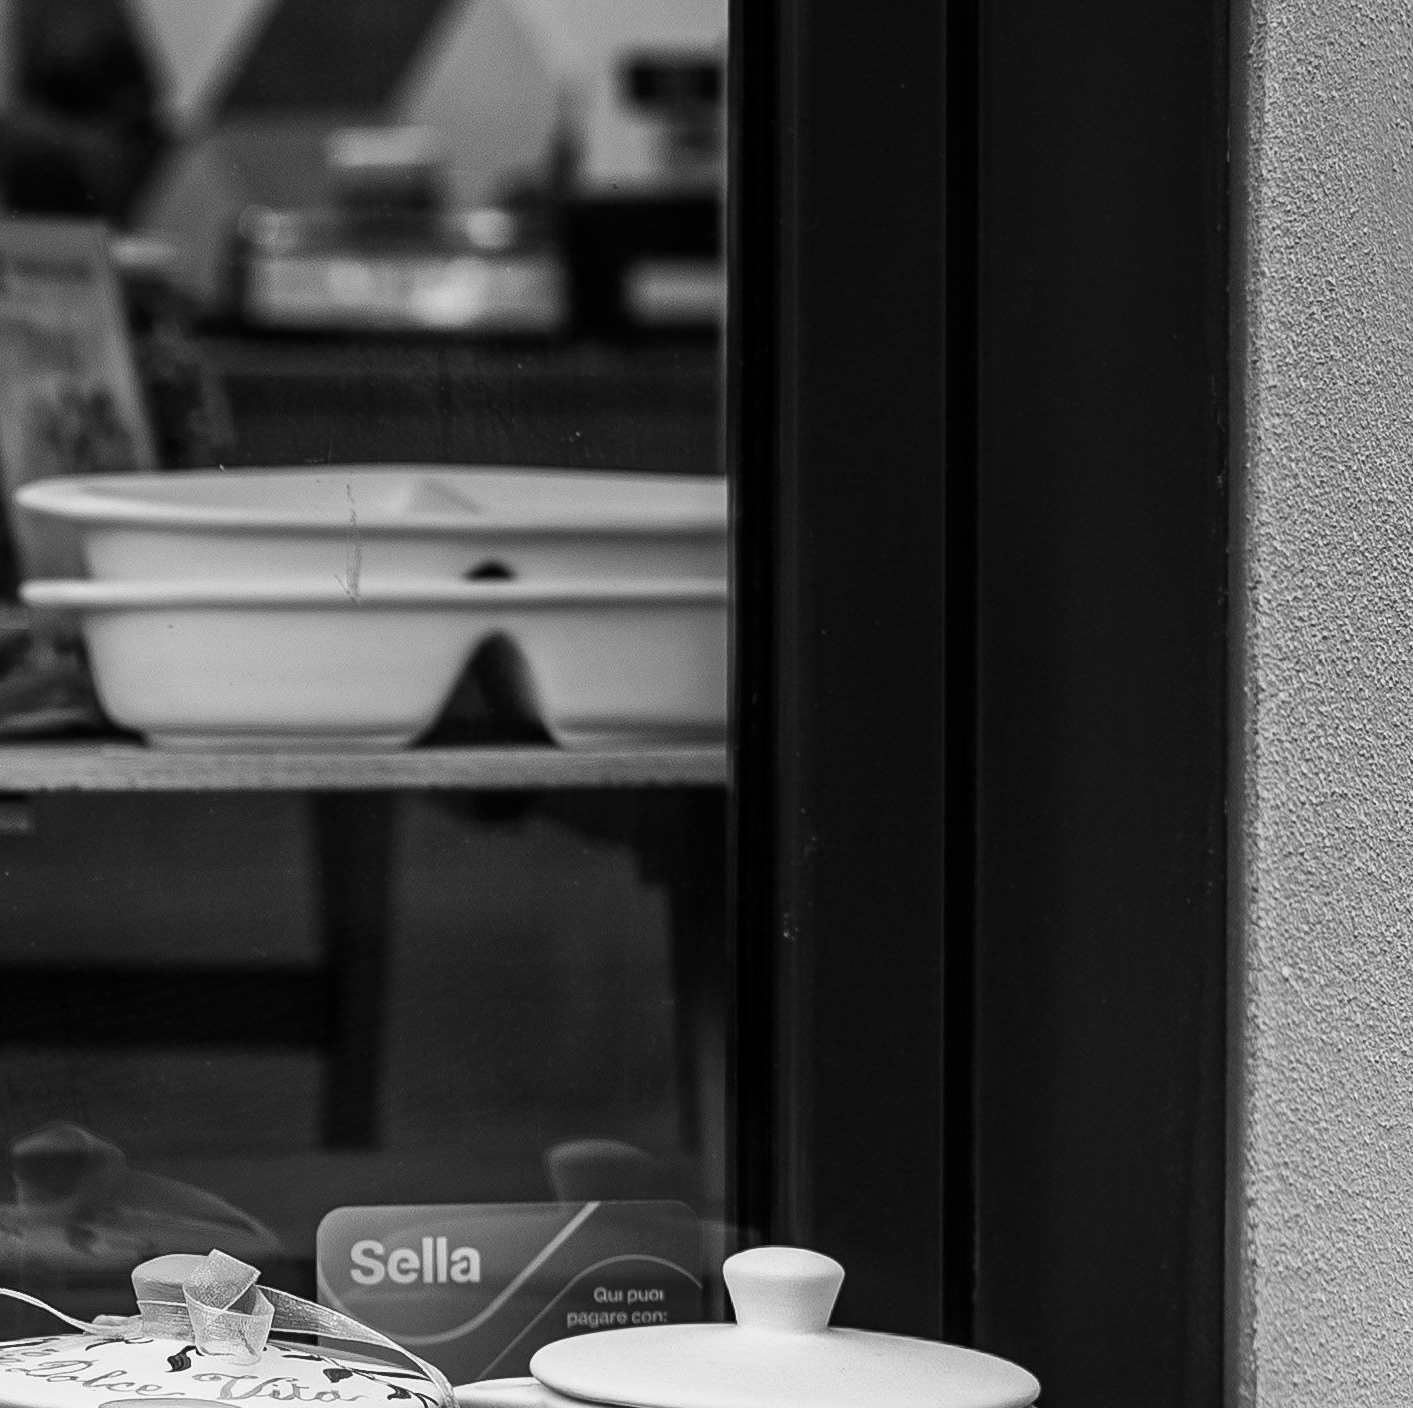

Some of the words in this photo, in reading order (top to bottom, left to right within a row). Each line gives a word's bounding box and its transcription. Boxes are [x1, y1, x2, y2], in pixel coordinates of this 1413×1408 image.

[349, 1236, 481, 1285] Sella
[593, 1286, 623, 1303] Qui
[626, 1288, 665, 1305] puoi
[566, 1310, 627, 1329] pagare
[192, 1372, 370, 1402] Vita
